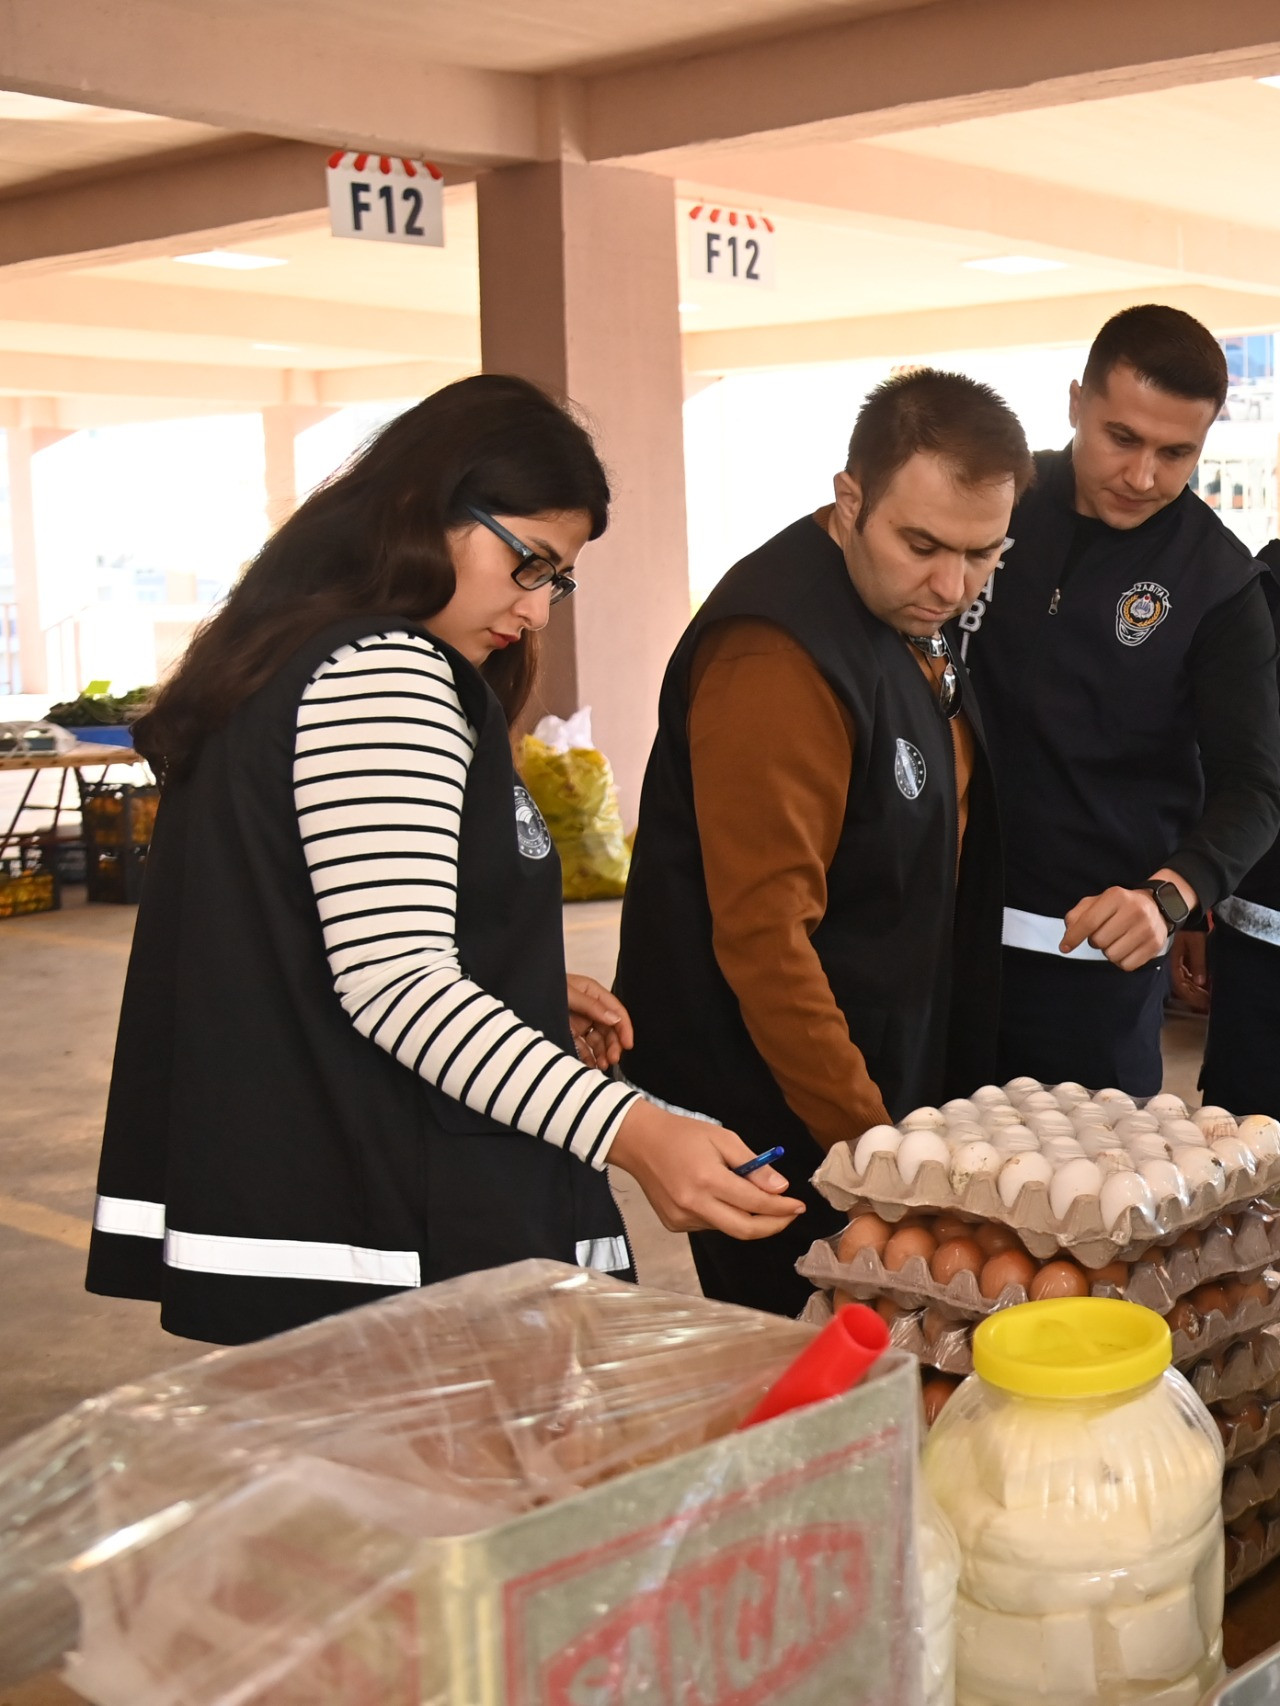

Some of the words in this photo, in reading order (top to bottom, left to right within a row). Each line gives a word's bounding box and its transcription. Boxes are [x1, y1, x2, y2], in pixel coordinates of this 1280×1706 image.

[350, 181, 425, 236] F12
[706, 232, 760, 280] F12
[1135, 584, 1165, 599] ZABITA
